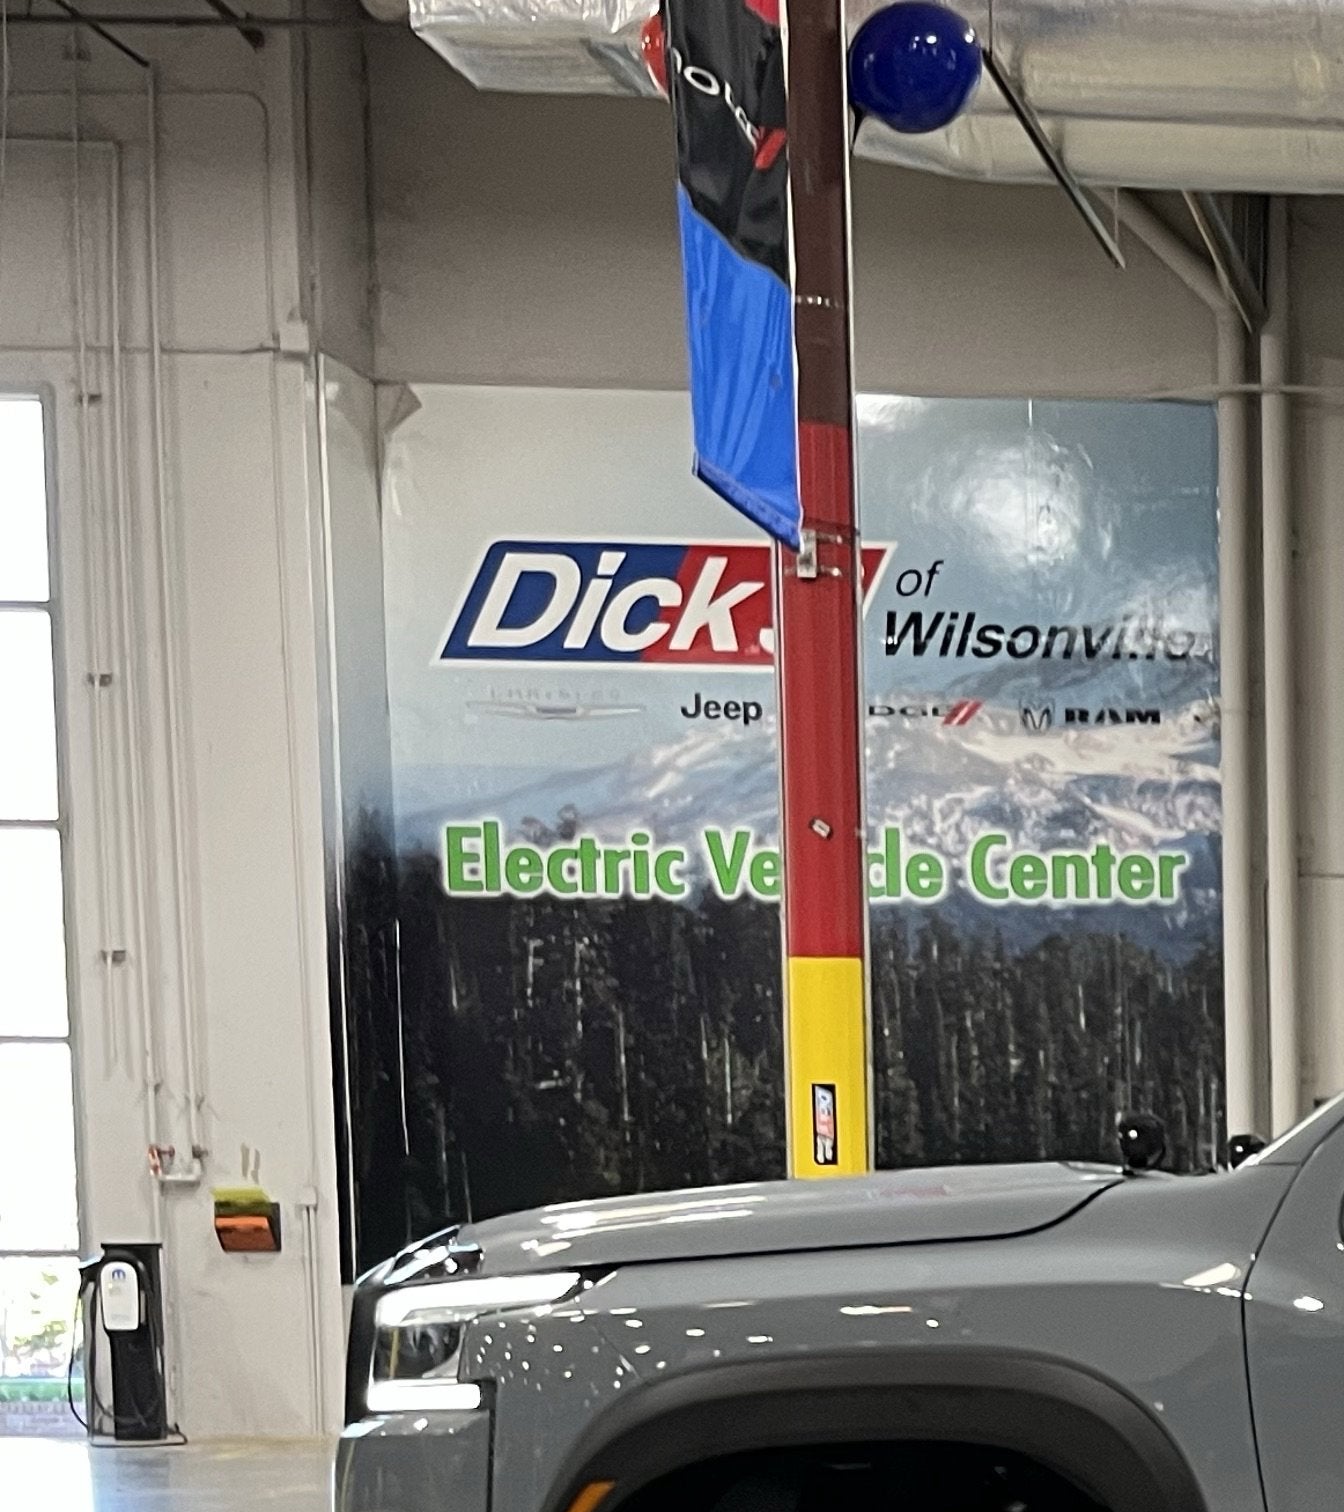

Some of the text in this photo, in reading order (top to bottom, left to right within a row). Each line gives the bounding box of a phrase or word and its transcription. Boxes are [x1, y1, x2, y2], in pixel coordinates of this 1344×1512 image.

[895, 560, 945, 597] of
[680, 693, 763, 725] Jeep
[1065, 708, 1161, 725] RAM
[446, 821, 1187, 900] Electric Vecle Center
